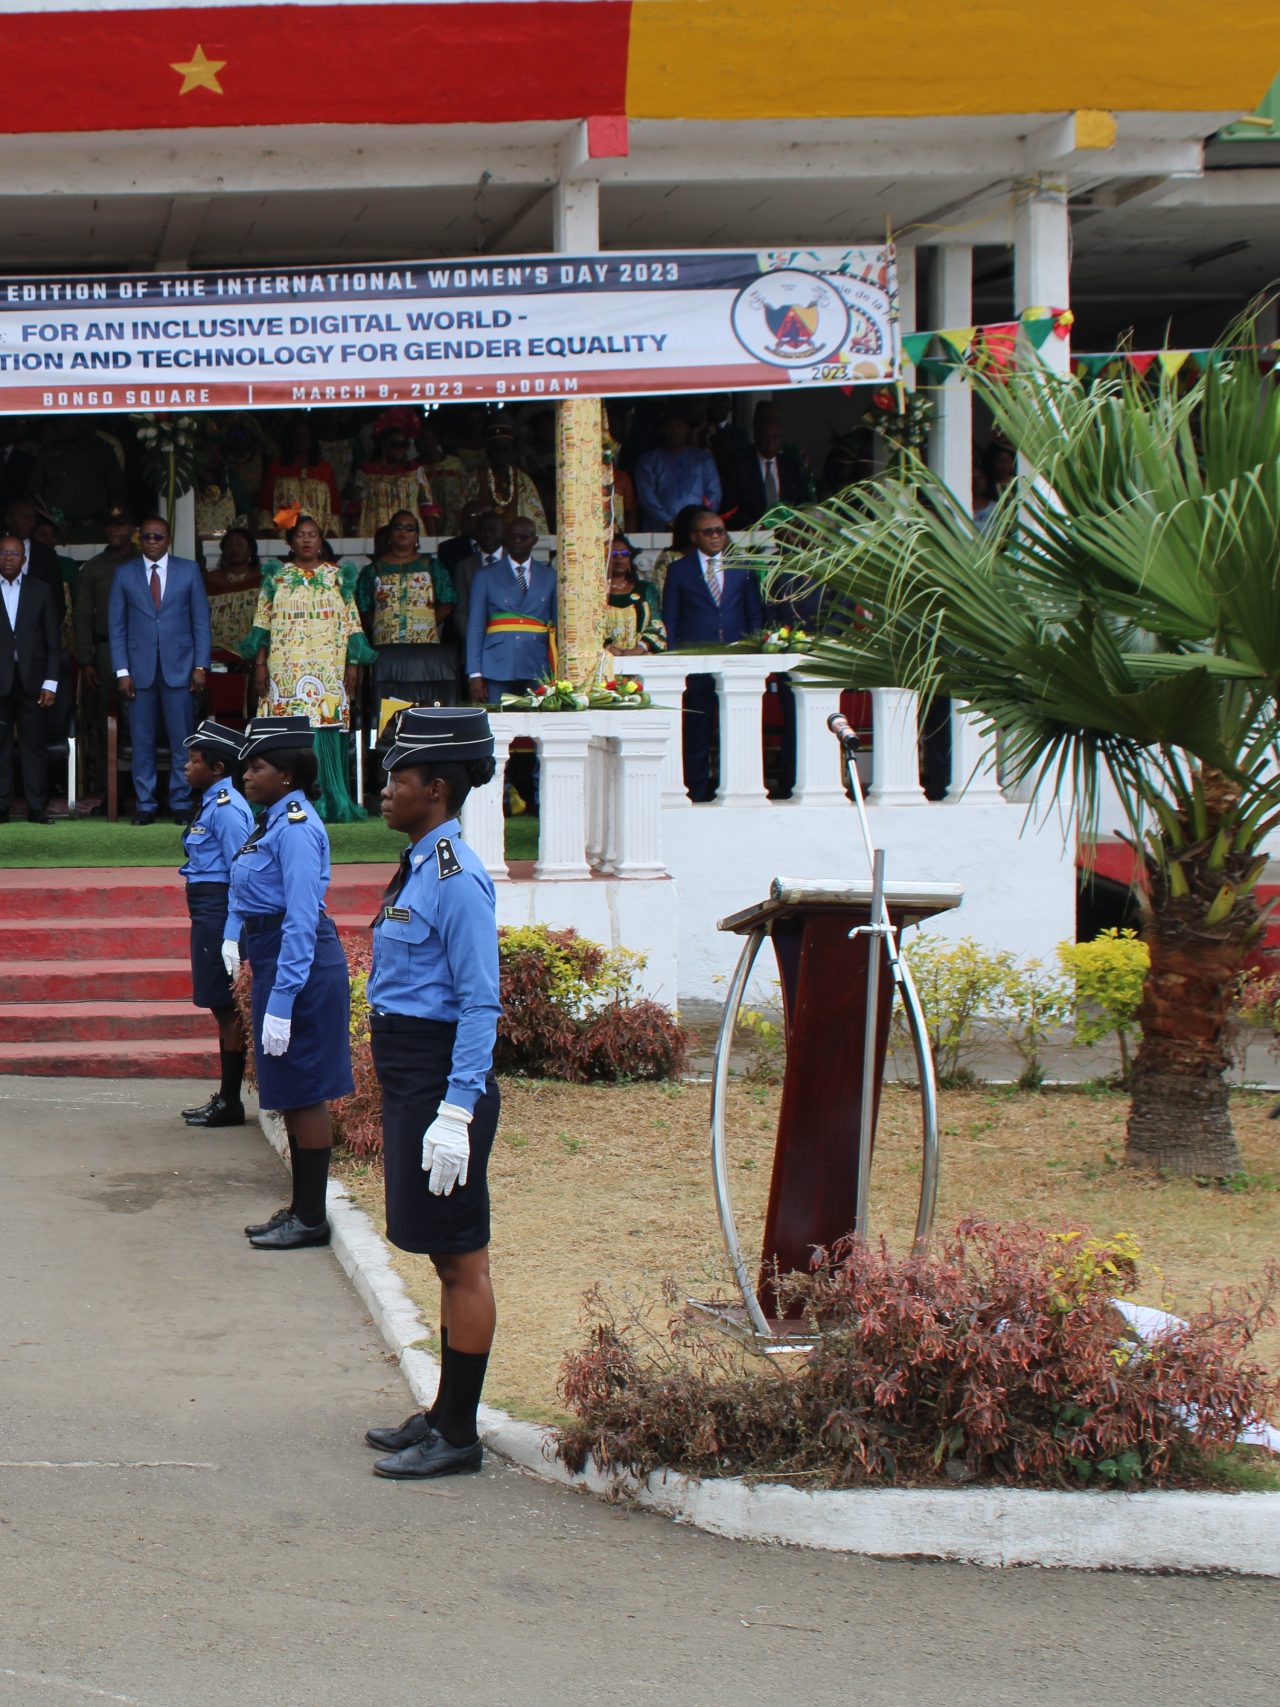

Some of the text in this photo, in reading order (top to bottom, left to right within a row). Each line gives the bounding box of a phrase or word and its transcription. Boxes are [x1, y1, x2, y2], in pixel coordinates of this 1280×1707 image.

[6, 283, 107, 303] EDITION
[118, 281, 148, 299] OF
[159, 279, 206, 298] THE
[217, 270, 418, 296] INTERNATIONAL
[427, 265, 549, 289] WOMEN'S
[560, 264, 609, 284] DAY
[619, 262, 679, 282] 2023
[21, 323, 79, 343] FOR
[84, 321, 125, 341] AN
[131, 317, 284, 340] INCLUSIVE
[289, 313, 401, 335] DIGITAL
[406, 309, 512, 331] WORLD
[70, 350, 132, 369] AND
[136, 345, 335, 369] TECHNOLOGY
[340, 343, 398, 363] FOR
[403, 338, 522, 361] GENDER
[527, 333, 668, 358] EQUALITY
[811, 364, 850, 381] 2023
[42, 391, 114, 406] BONGO
[125, 388, 211, 406] SQUARE
[291, 384, 367, 402] MARCH
[378, 383, 400, 401] 8,
[411, 380, 464, 398] 2023
